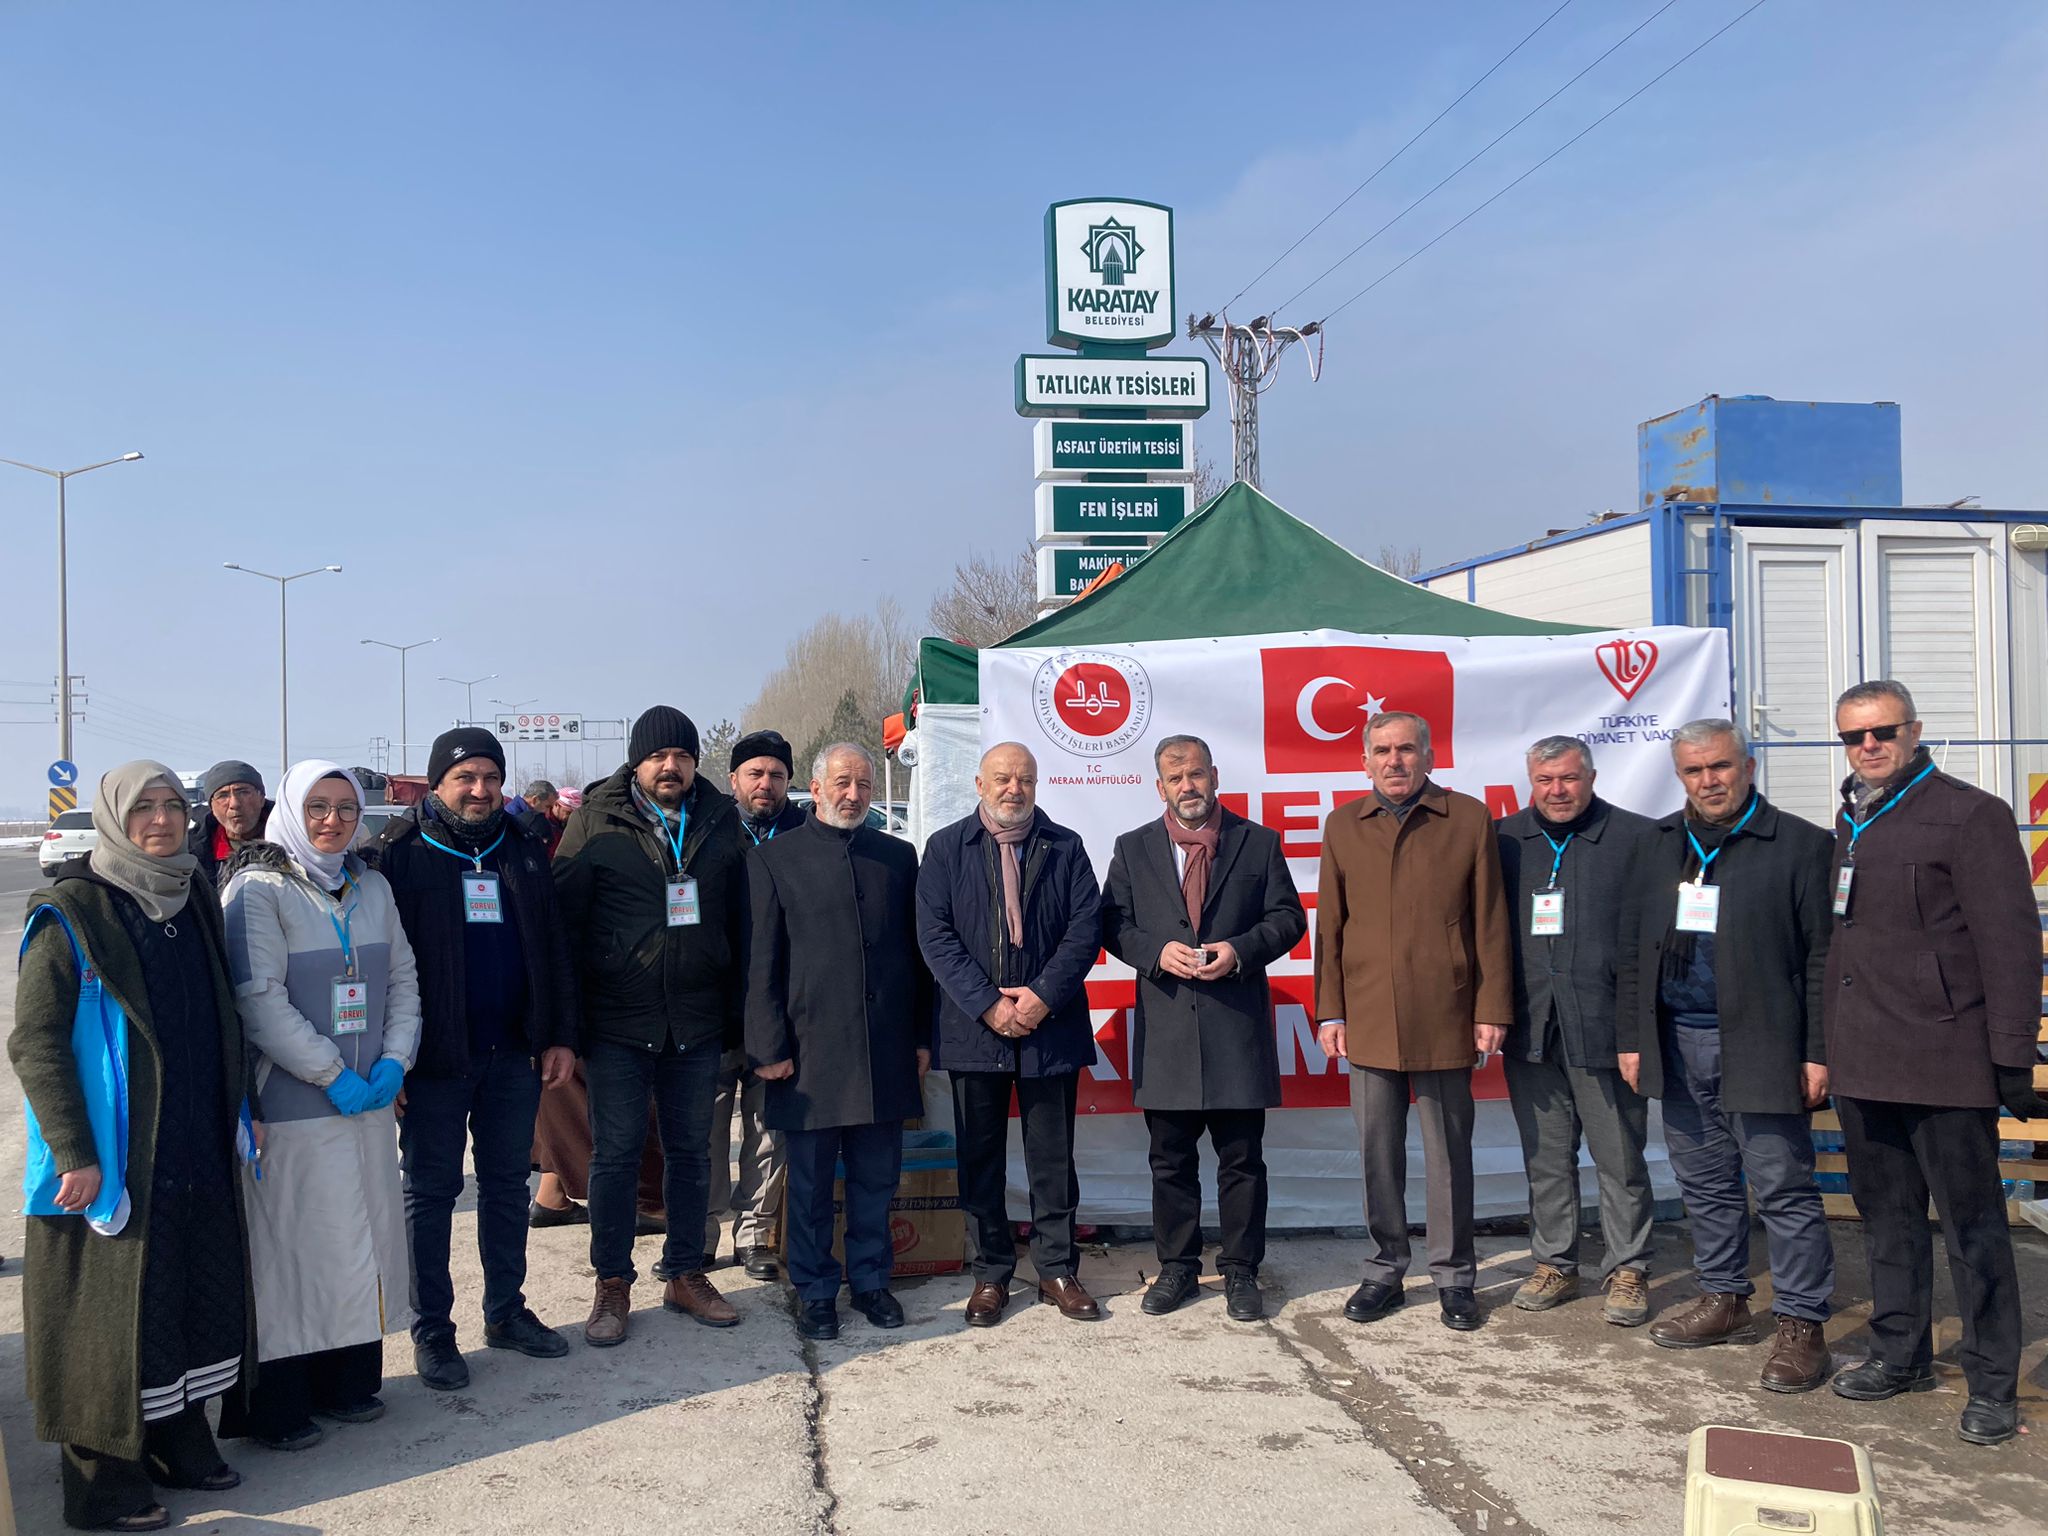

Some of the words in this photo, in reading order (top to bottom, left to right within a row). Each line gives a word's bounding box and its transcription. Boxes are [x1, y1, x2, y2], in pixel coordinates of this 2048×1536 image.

[1068, 288, 1159, 313] KARATAY
[1085, 314, 1144, 326] BELEDİYESİ
[1037, 374, 1112, 395] TATLICAK
[1116, 370, 1195, 396] TESİSLERİ
[1056, 440, 1096, 454] ASFALT
[1099, 437, 1141, 454] ÜRETİM
[1144, 438, 1180, 455] TESİSİ
[1080, 501, 1106, 517] FEN
[1112, 497, 1158, 520] İŞLERİ
[1040, 698, 1068, 741] DİYANET
[1068, 736, 1103, 752] İŞLERİ
[1106, 700, 1146, 749] BAŞKANLIĞI
[1599, 713, 1659, 728] TÜRKİYE
[1049, 776, 1084, 785] MERAM
[1086, 774, 1142, 785] MÜFTÜLÜĞÜ
